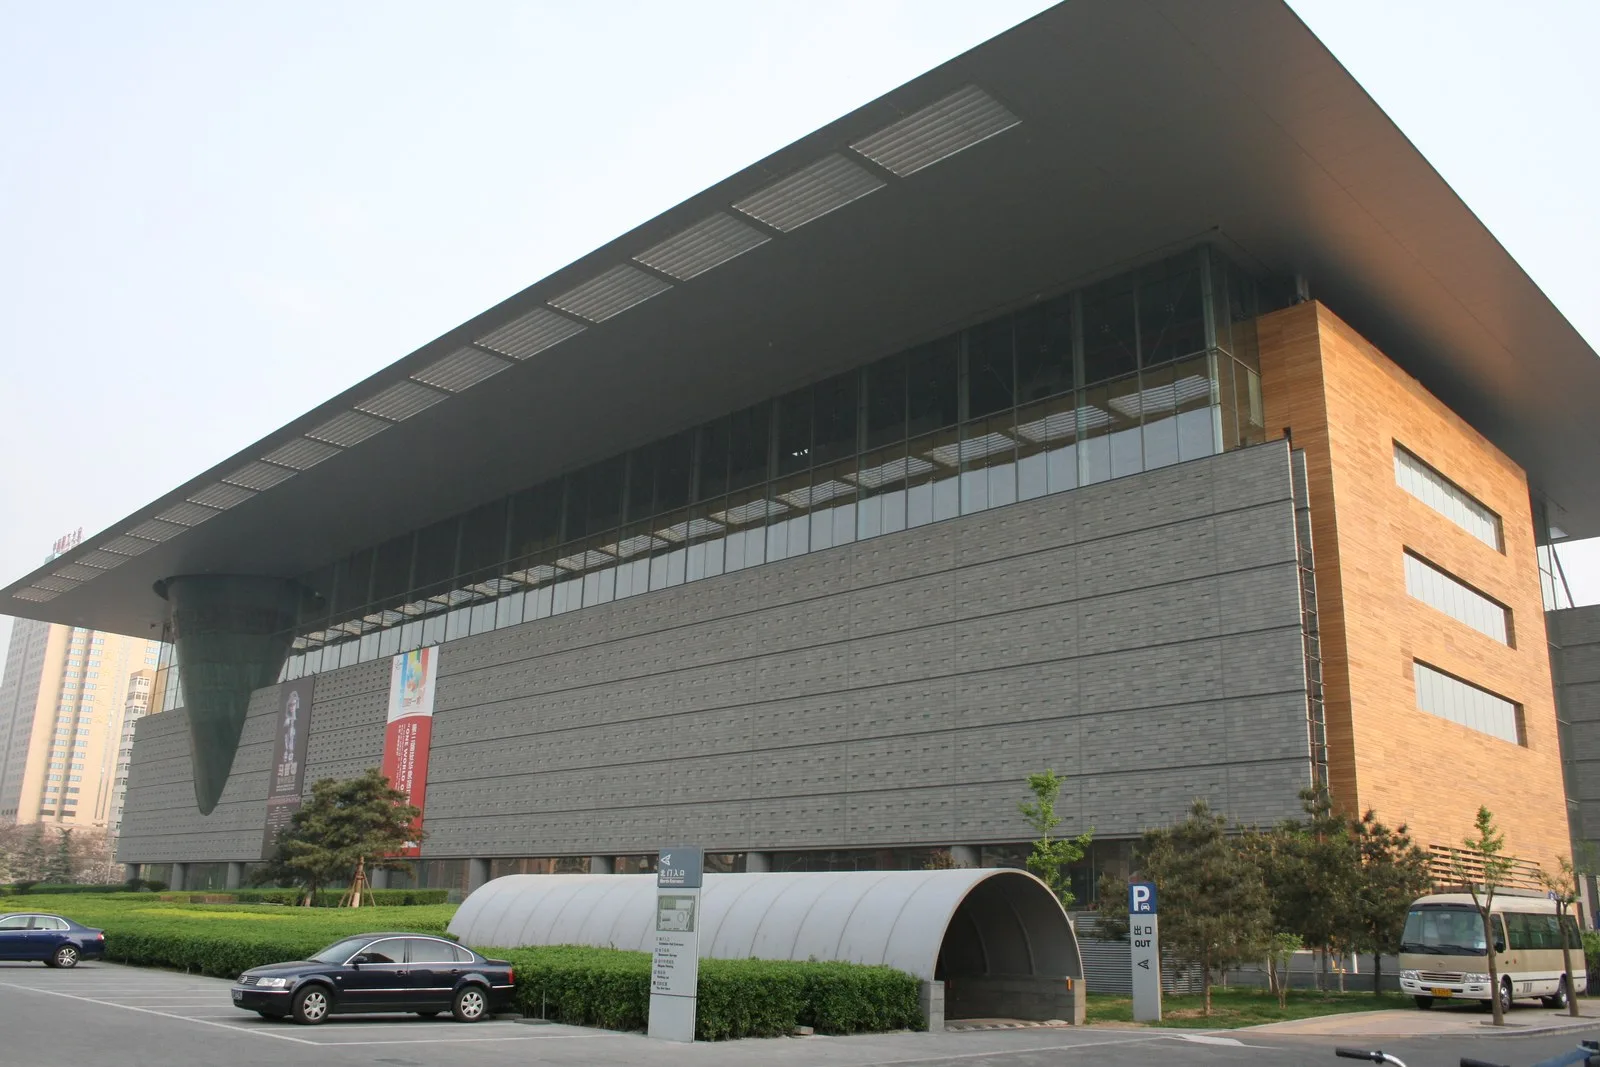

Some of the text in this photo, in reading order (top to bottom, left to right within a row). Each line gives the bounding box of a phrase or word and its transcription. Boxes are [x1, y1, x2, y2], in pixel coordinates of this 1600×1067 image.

[1132, 885, 1150, 912] P
[1133, 925, 1152, 935] 出口
[1134, 939, 1151, 948] OUT
